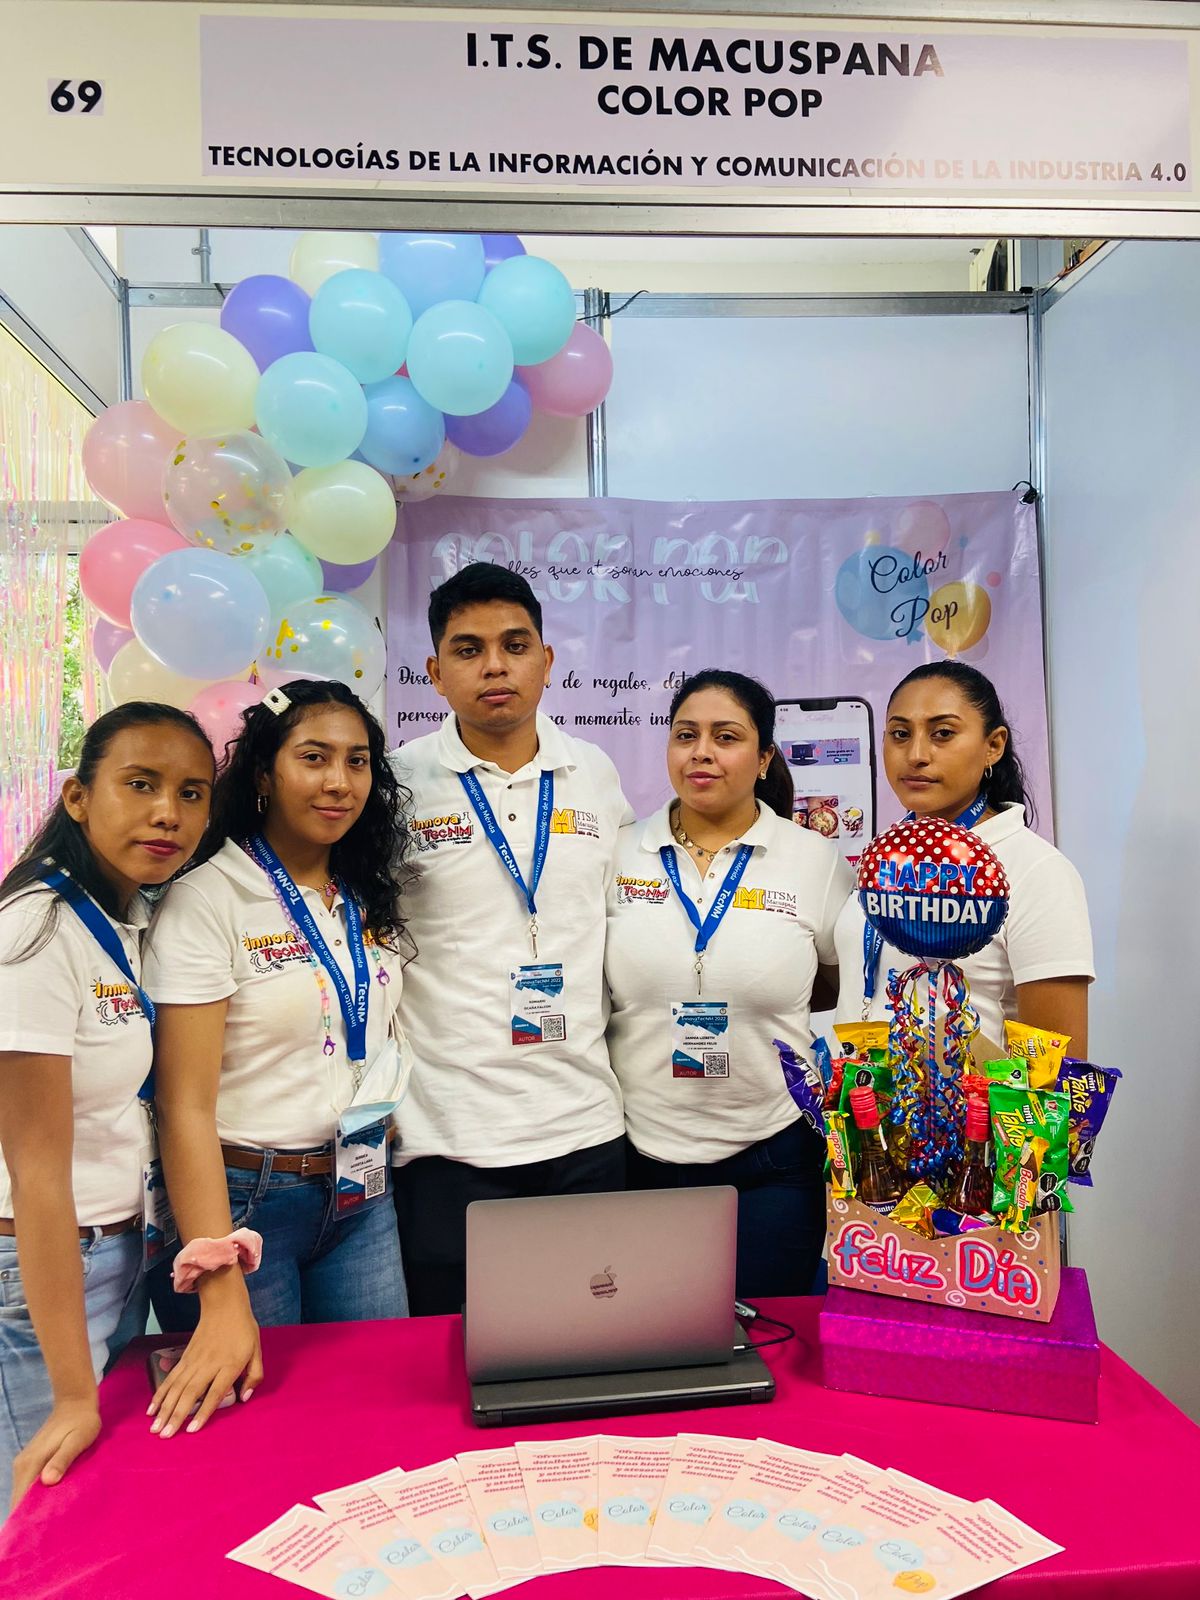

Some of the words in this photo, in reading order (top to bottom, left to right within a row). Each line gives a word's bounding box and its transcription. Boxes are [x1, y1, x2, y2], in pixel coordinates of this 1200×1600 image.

[466, 33, 562, 70] I.T.S.
[579, 36, 633, 70] DE
[648, 38, 944, 77] MACUSPANA
[50, 80, 102, 113] 69
[597, 85, 731, 117] COLOR
[746, 89, 823, 118] POP
[208, 142, 400, 171] TECNOLOGÍAS
[409, 151, 441, 171] DE
[449, 152, 480, 173] LA
[489, 149, 683, 176] INFORMACIÓN
[691, 155, 707, 177] Y
[716, 152, 925, 180] COMUNICACIÓN
[934, 160, 965, 180] DE
[972, 161, 1001, 181] LA
[1009, 161, 1143, 183] INDUSTRIA
[1151, 163, 1187, 183] 4.0
[548, 564, 581, 581] que
[658, 566, 744, 581] emociones
[868, 551, 947, 594] Color
[891, 595, 958, 638] Pop
[562, 670, 582, 689] de
[593, 671, 651, 698] regalos,
[574, 707, 642, 726] momentos
[410, 815, 461, 831] Innova
[422, 825, 473, 842] TecNM
[498, 842, 520, 878] TecNM
[272, 867, 301, 905] TecNM
[616, 875, 661, 888] Innova
[878, 859, 978, 893] HAPPY
[624, 885, 669, 899] TecNM
[767, 890, 797, 904] ITSM
[711, 889, 731, 919] TecNM
[866, 892, 994, 924] BIRTHDAY
[303, 914, 319, 942] Mérida
[243, 932, 298, 951] Innova
[358, 981, 368, 1023] TecNM
[1068, 1075, 1089, 1114] Takis
[1018, 1167, 1033, 1211] Bocadin
[561, 1461, 598, 1469] historia
[681, 1471, 735, 1481] emociones
[712, 1461, 741, 1469] histor
[749, 1477, 801, 1492] emociones
[540, 1507, 577, 1522] Color
[608, 1504, 645, 1518] Color
[669, 1501, 706, 1513] Color
[727, 1505, 765, 1519] Color
